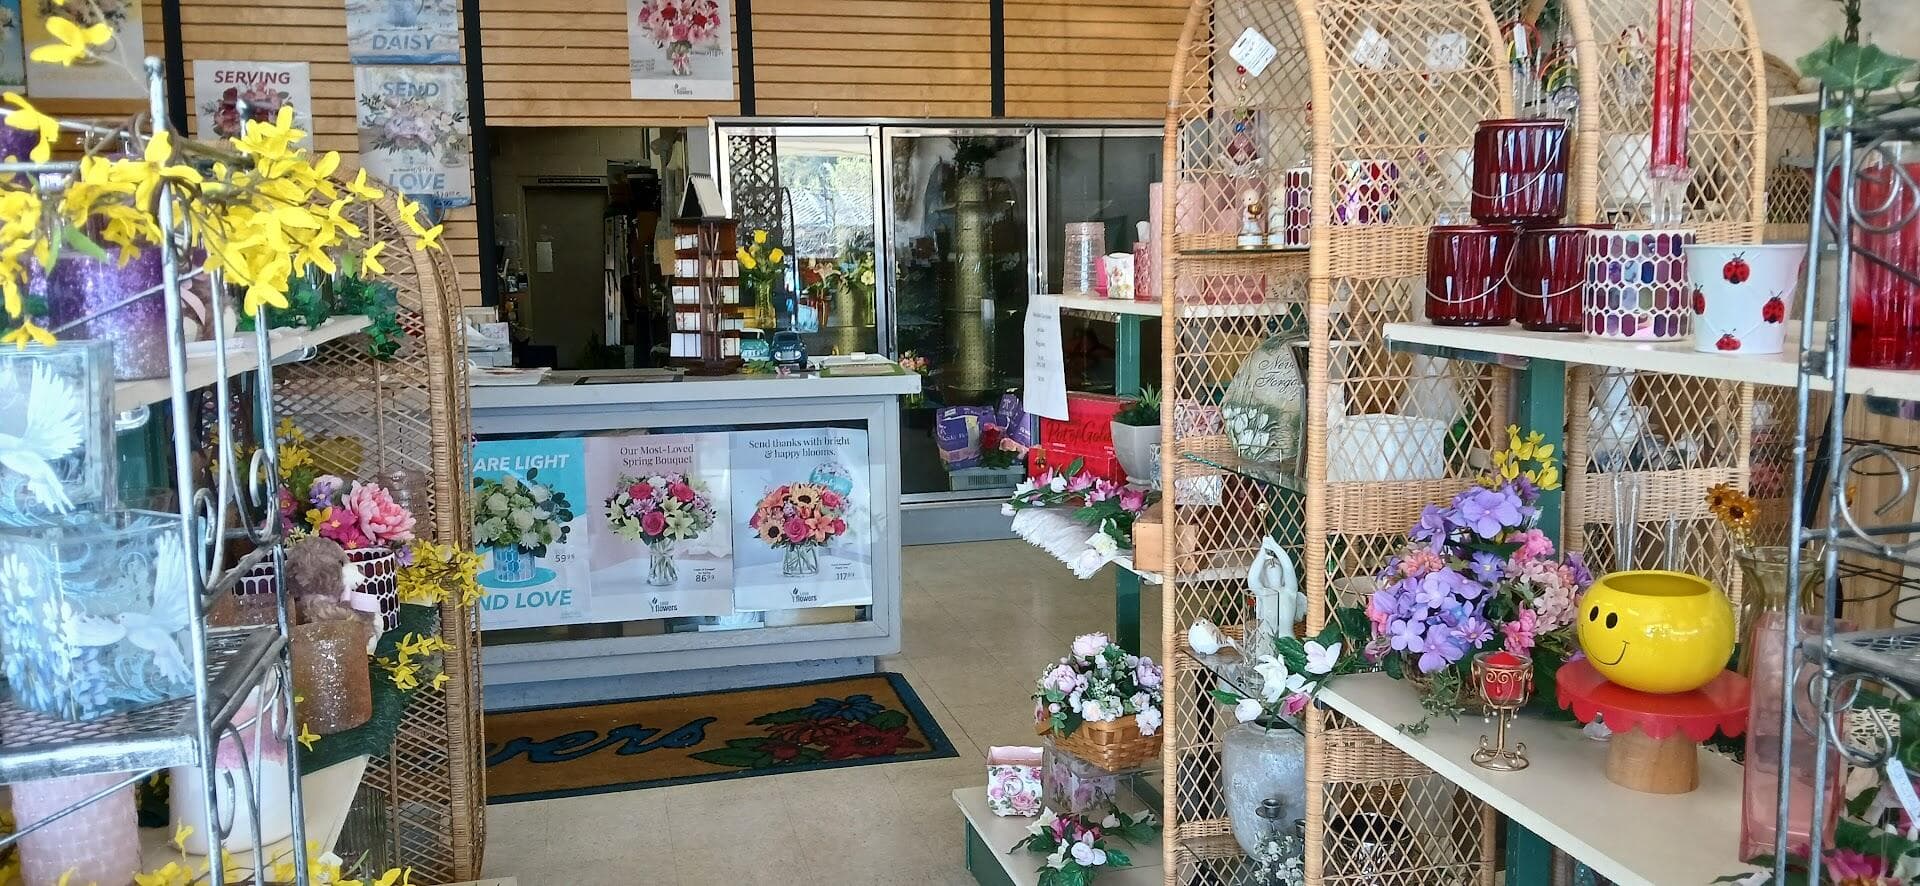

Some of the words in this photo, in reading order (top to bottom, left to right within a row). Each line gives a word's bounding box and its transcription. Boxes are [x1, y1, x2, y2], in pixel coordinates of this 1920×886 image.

[372, 34, 436, 50] DAISY
[214, 70, 291, 85] SERVING
[382, 81, 440, 97] SEND
[388, 172, 446, 190] LOVE
[1258, 354, 1296, 371] Nev
[1254, 371, 1299, 394] Forgo
[620, 446, 639, 456] Our
[640, 443, 694, 455] Most-Loved
[748, 438, 771, 449] Send
[772, 437, 802, 448] thanks
[803, 436, 823, 447] with
[824, 435, 851, 447] bright
[622, 456, 653, 468] Spring
[655, 454, 692, 466] Bouquet
[764, 450, 773, 459] &
[774, 448, 801, 460] happy
[802, 447, 836, 457] blooms.
[472, 456, 511, 473] ARE
[515, 453, 571, 471] LIGHT
[515, 589, 573, 609] LOVE
[655, 604, 678, 613] flowers
